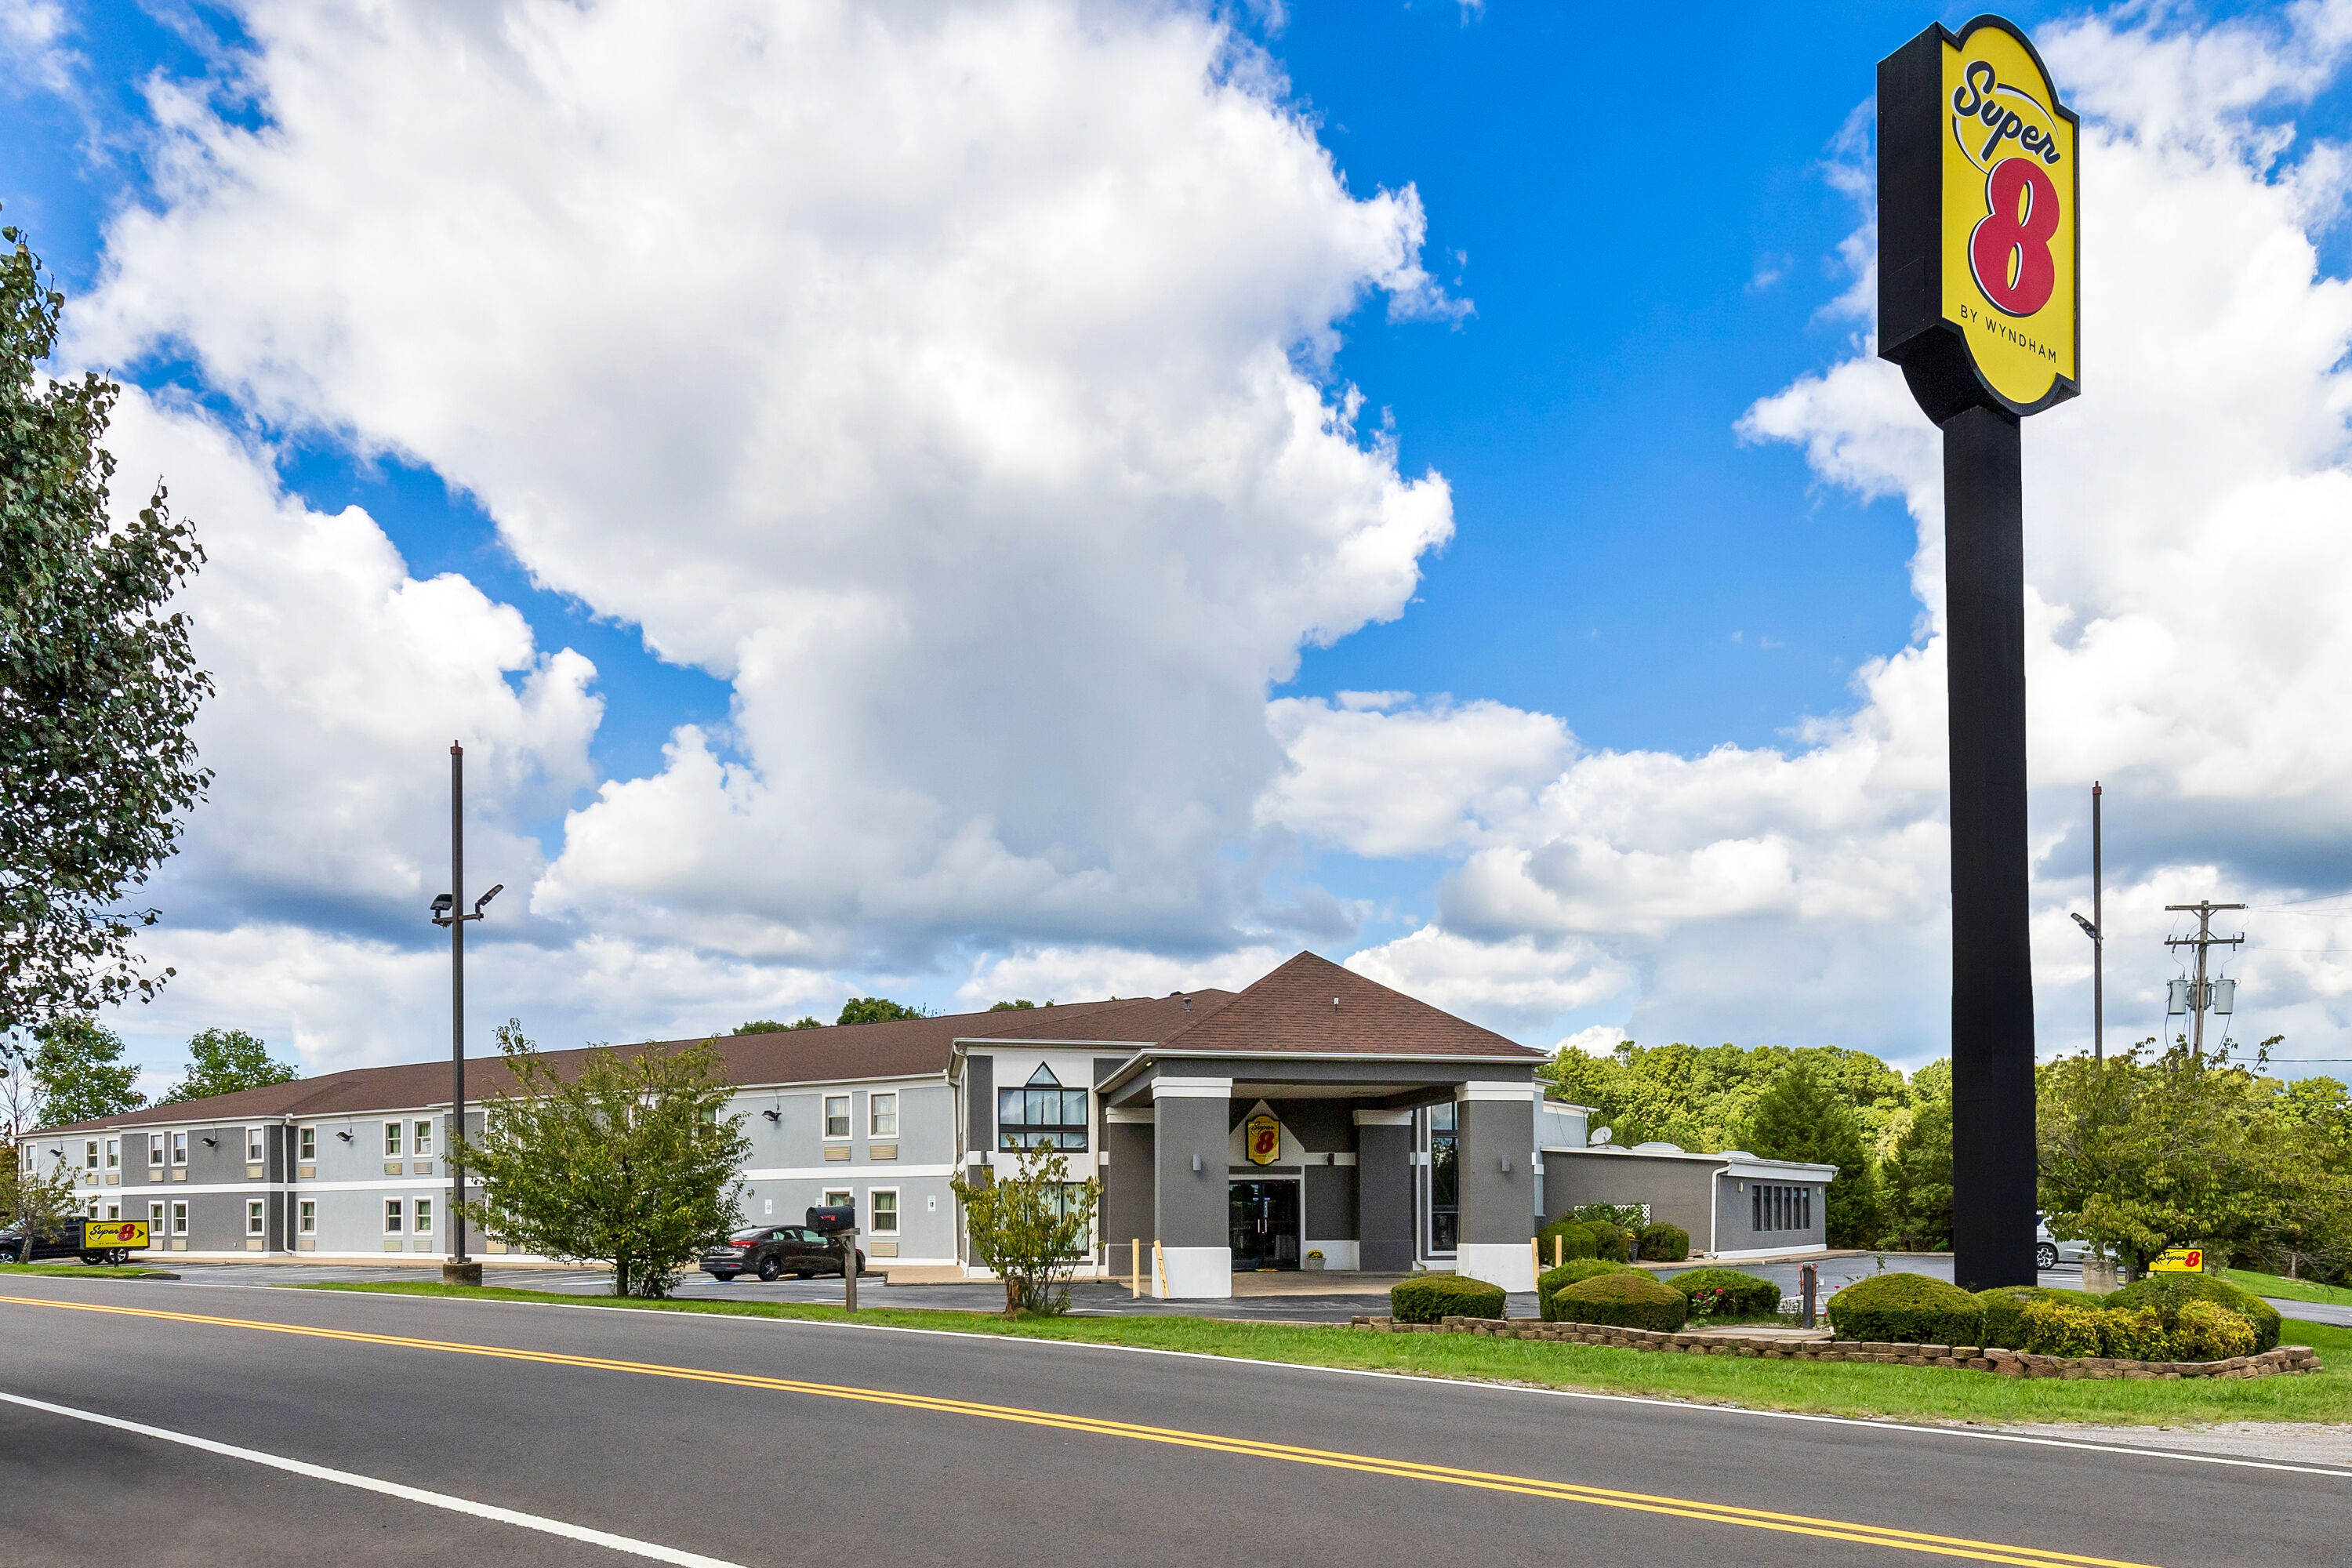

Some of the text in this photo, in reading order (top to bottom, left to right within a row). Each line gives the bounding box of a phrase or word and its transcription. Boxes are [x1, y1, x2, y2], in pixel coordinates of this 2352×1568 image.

[1951, 60, 2061, 165] Super
[1968, 157, 2060, 318] 8
[1961, 304, 2056, 364] BY WYNDHAM
[1254, 1131, 1275, 1154] 8
[89, 1223, 136, 1241] Super 8
[2183, 1251, 2201, 1267] 8
